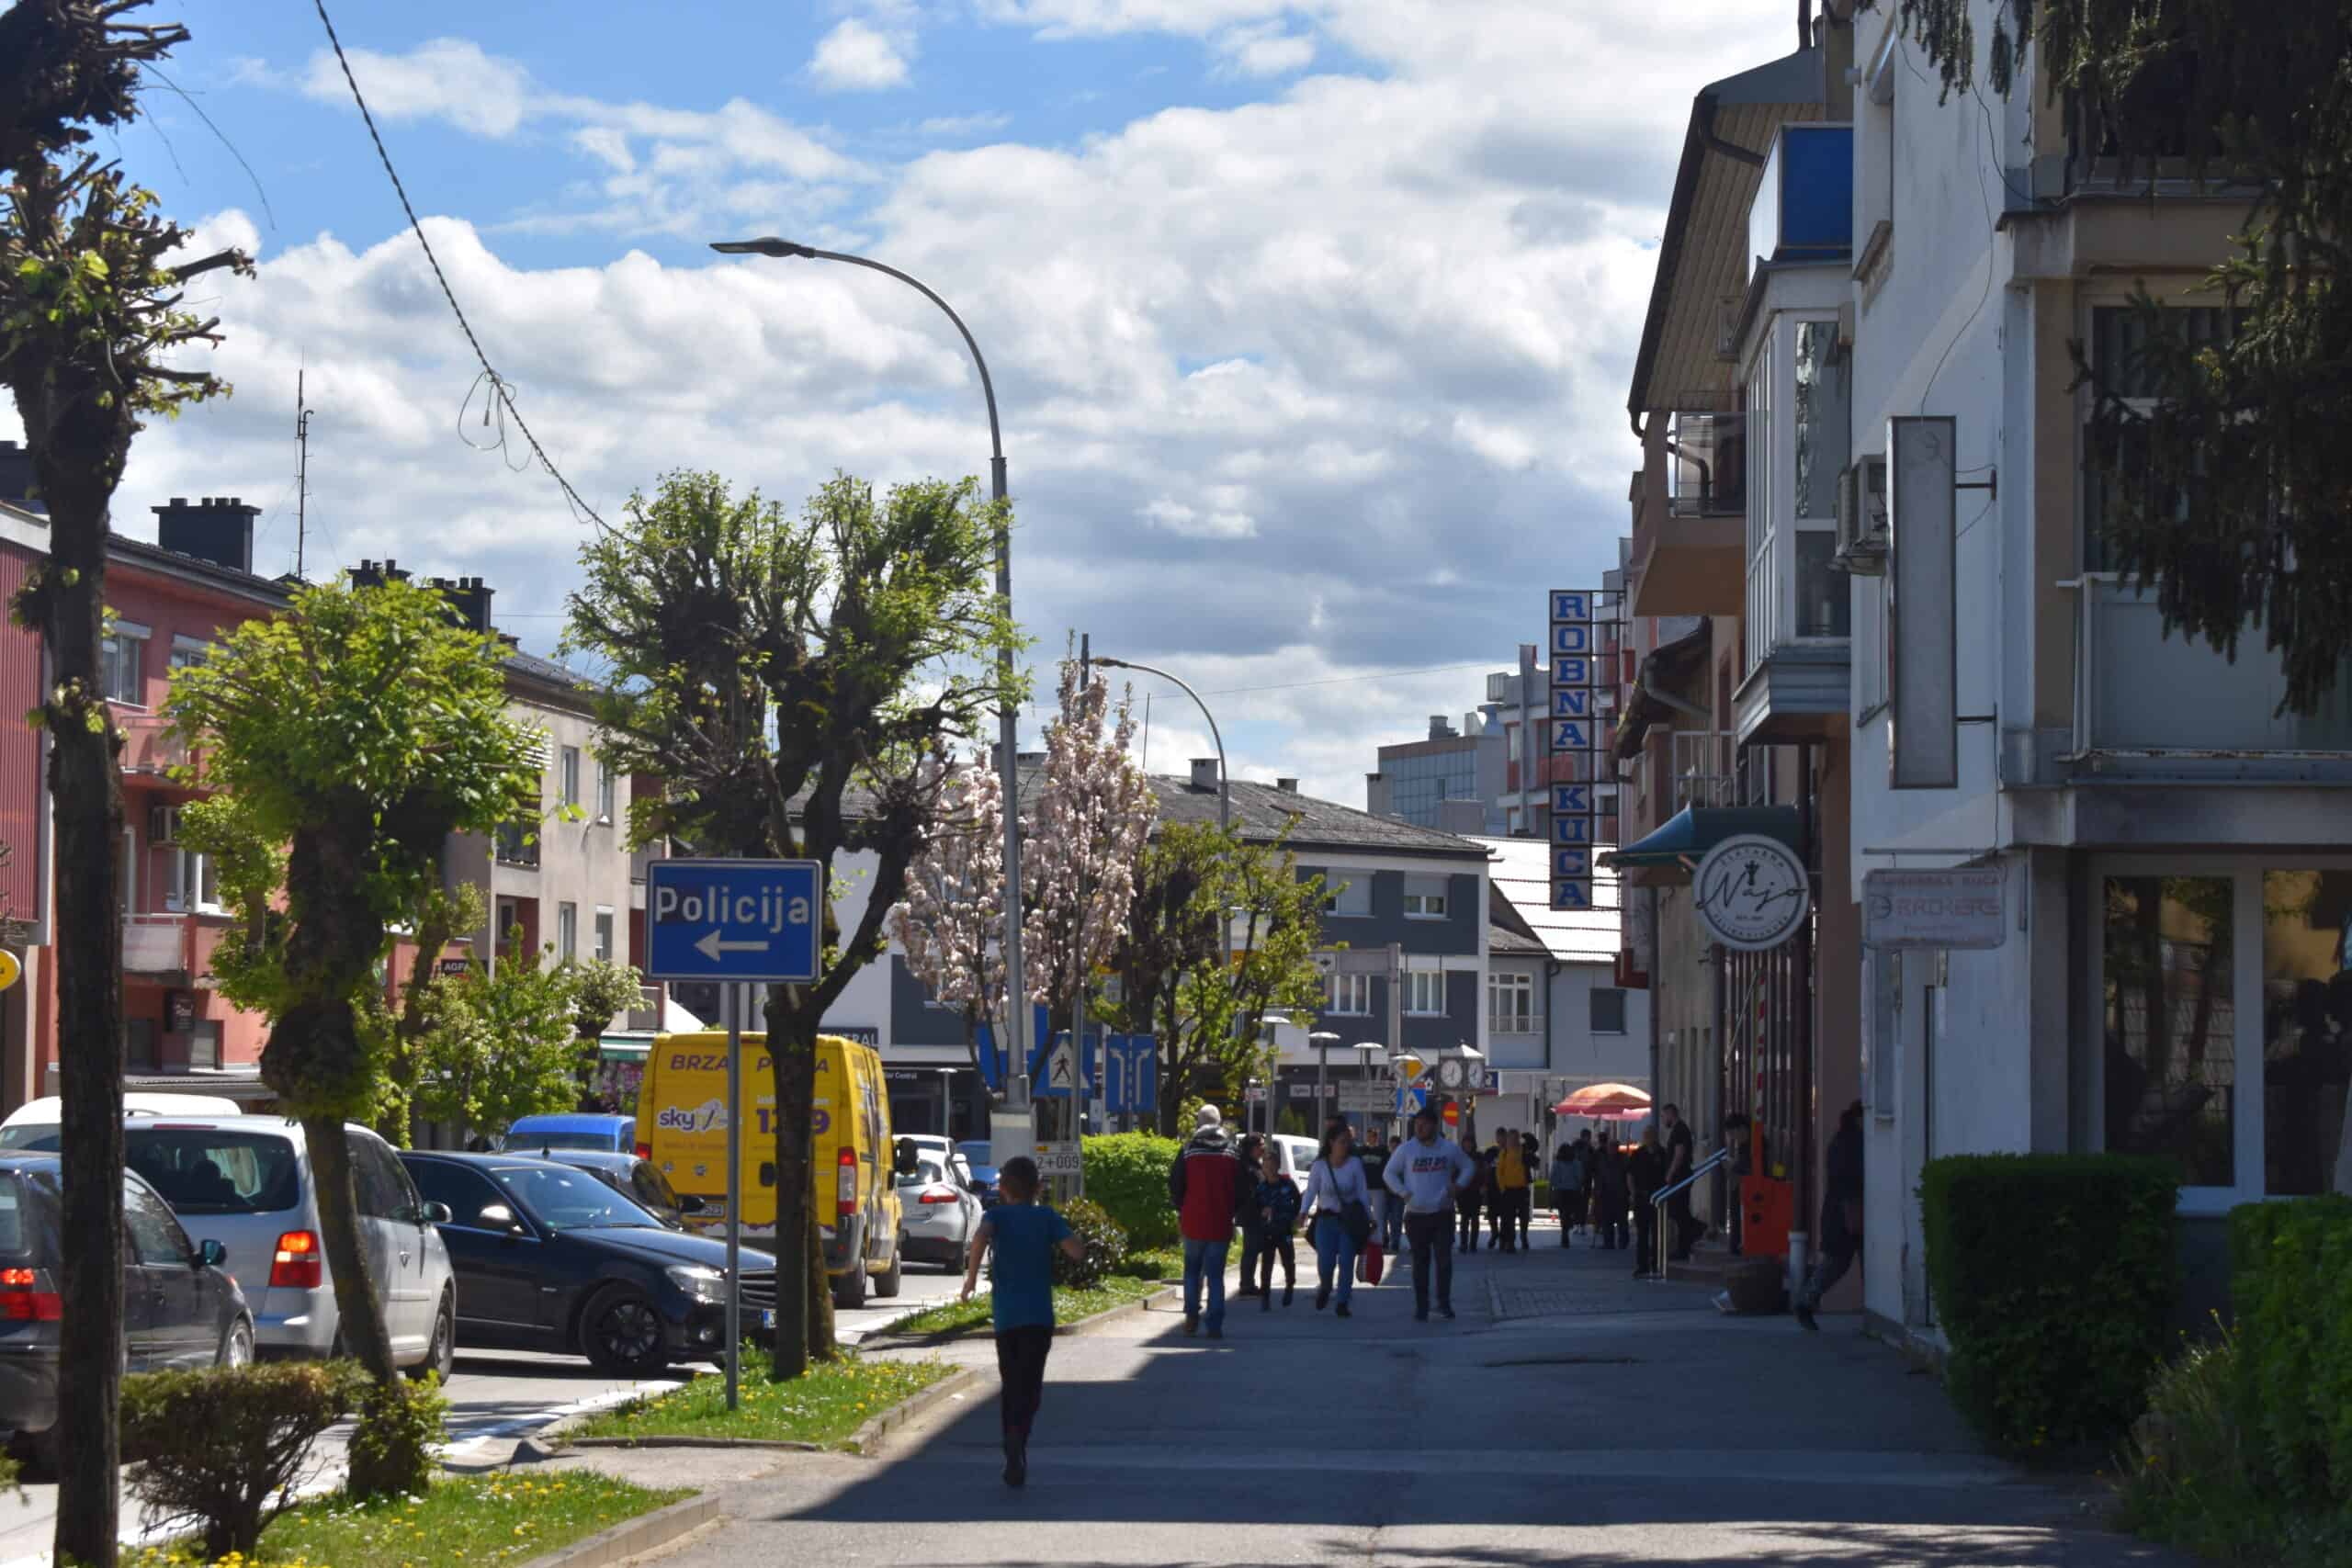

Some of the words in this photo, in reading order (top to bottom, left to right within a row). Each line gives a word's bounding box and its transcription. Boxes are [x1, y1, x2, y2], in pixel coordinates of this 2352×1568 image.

[1555, 594, 1587, 746] ROBNA
[655, 886, 809, 933] Policija
[671, 1055, 729, 1070] BRZA
